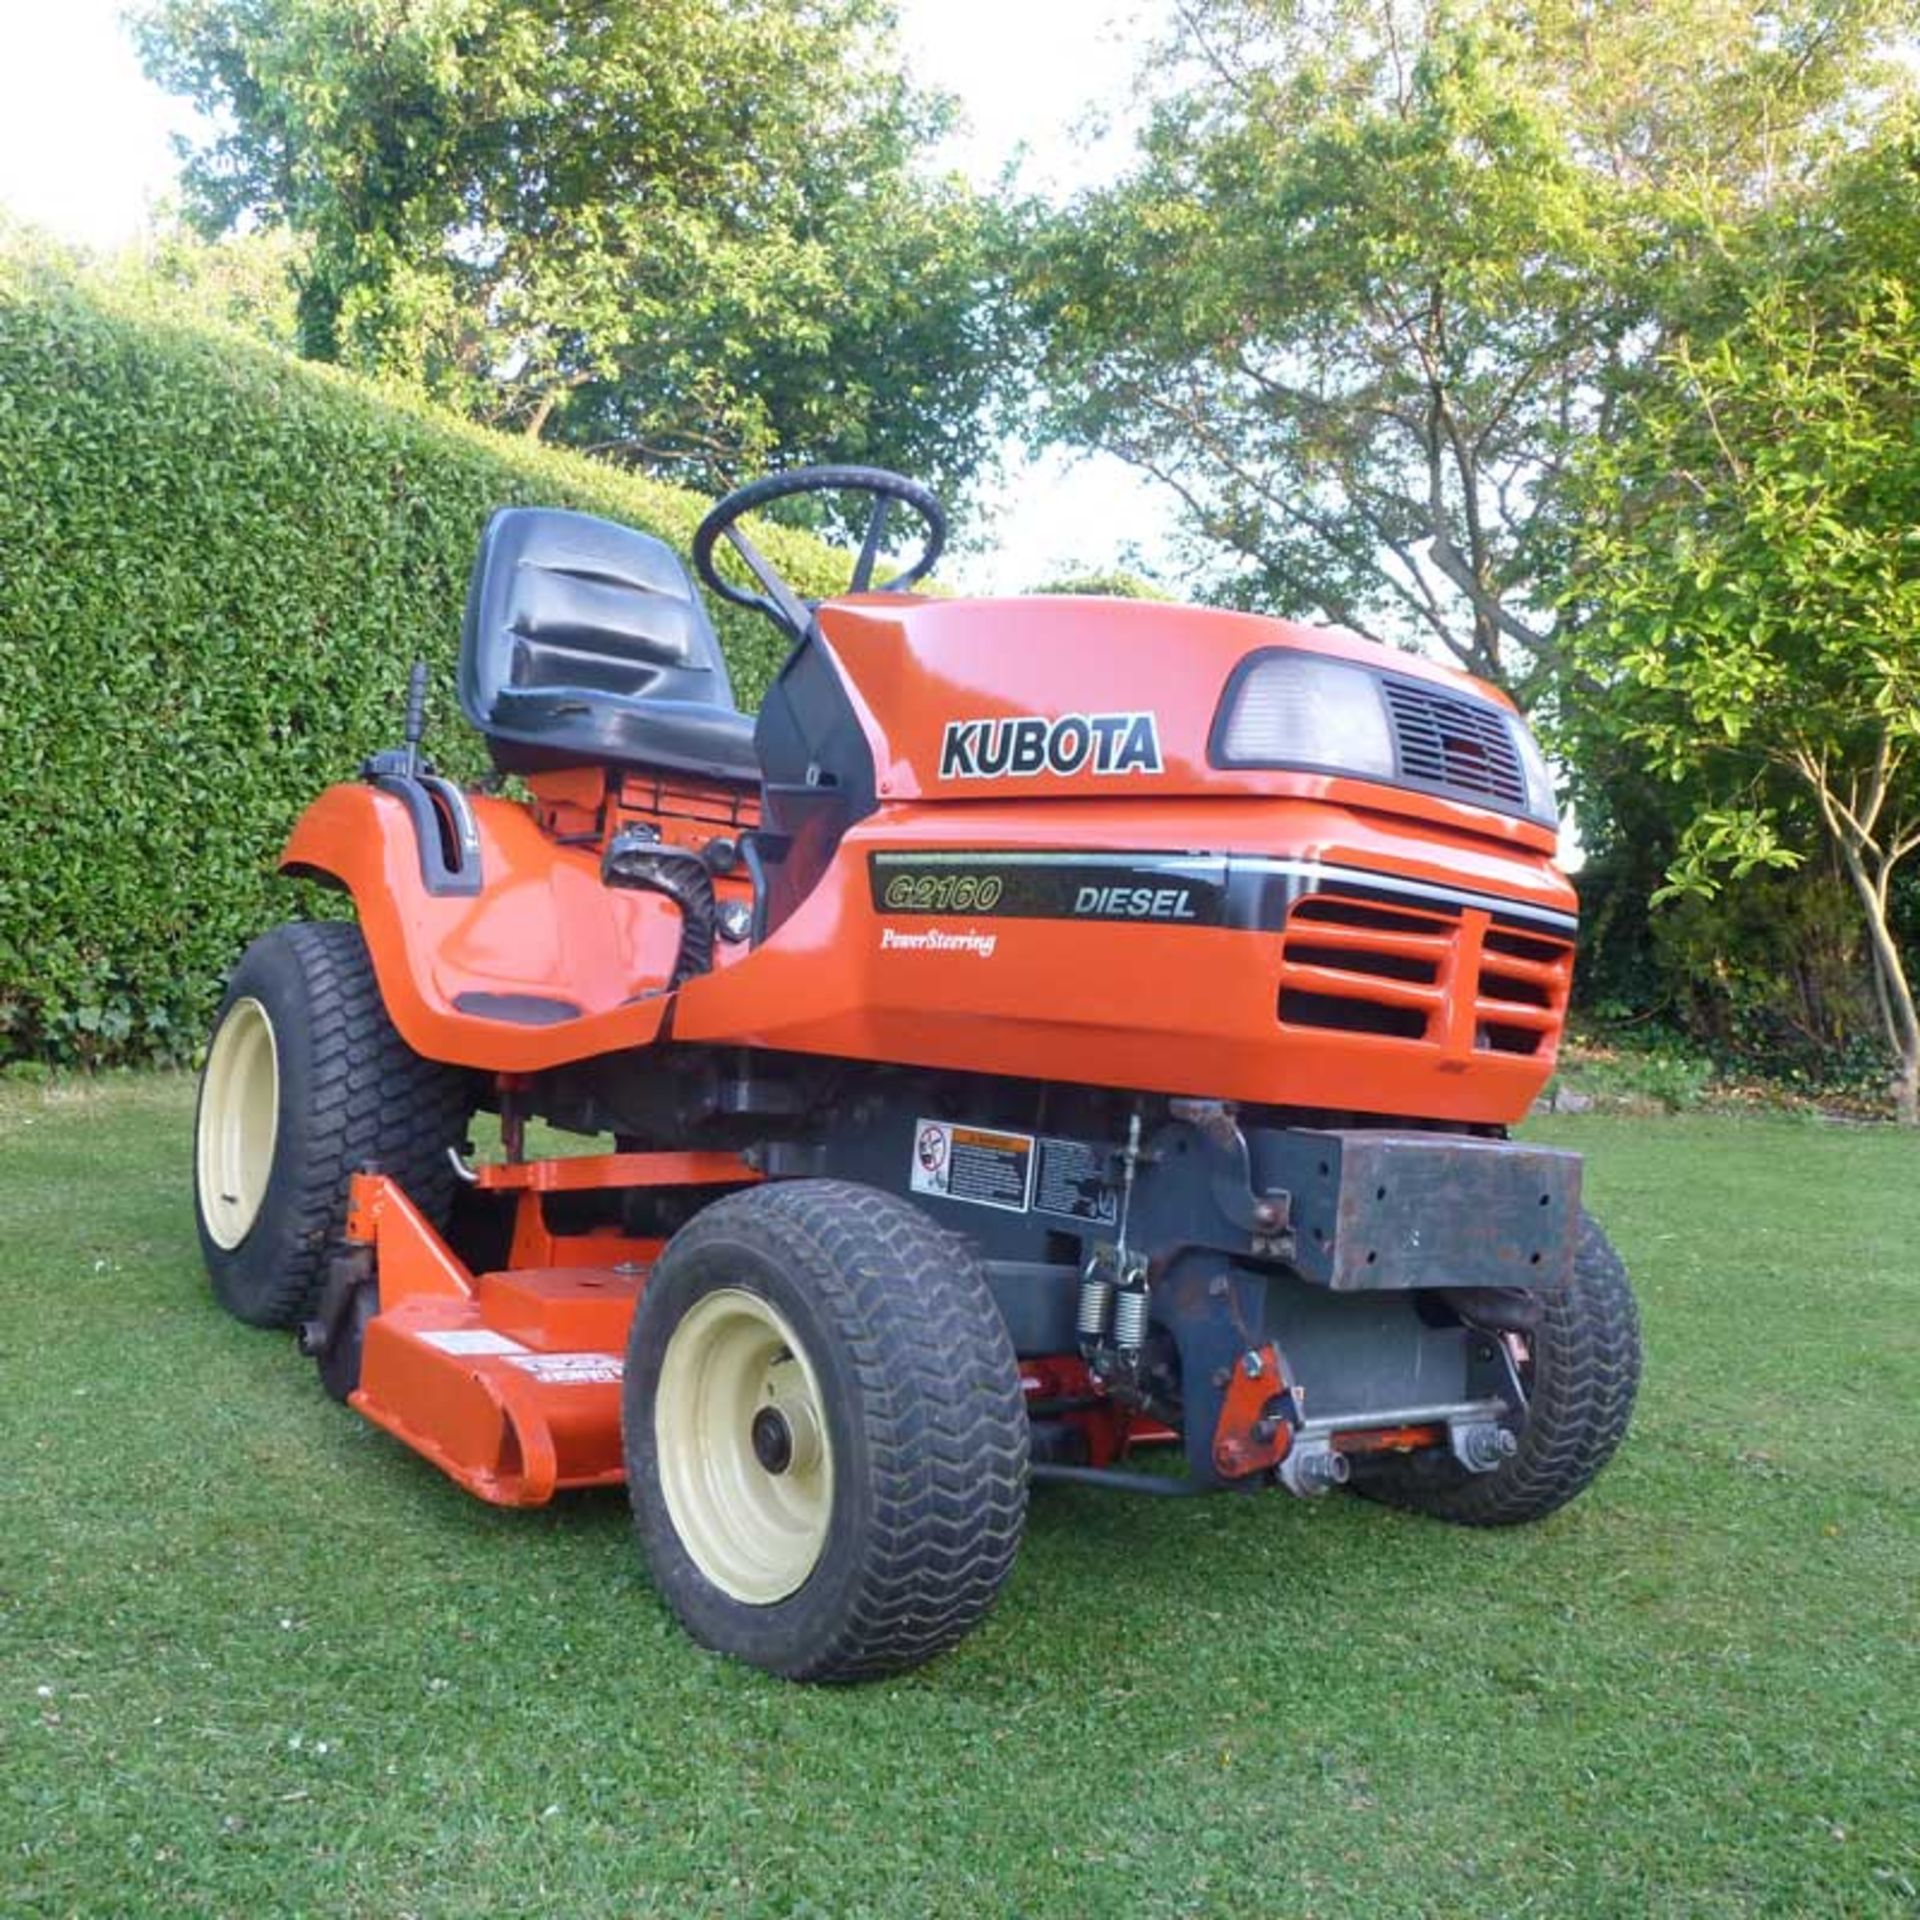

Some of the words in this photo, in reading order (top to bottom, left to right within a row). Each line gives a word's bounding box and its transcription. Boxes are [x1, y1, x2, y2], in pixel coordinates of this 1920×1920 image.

[939, 711, 1164, 779] KUBOTA
[885, 875, 1002, 909] G2160
[1074, 887, 1195, 917] DIESEL
